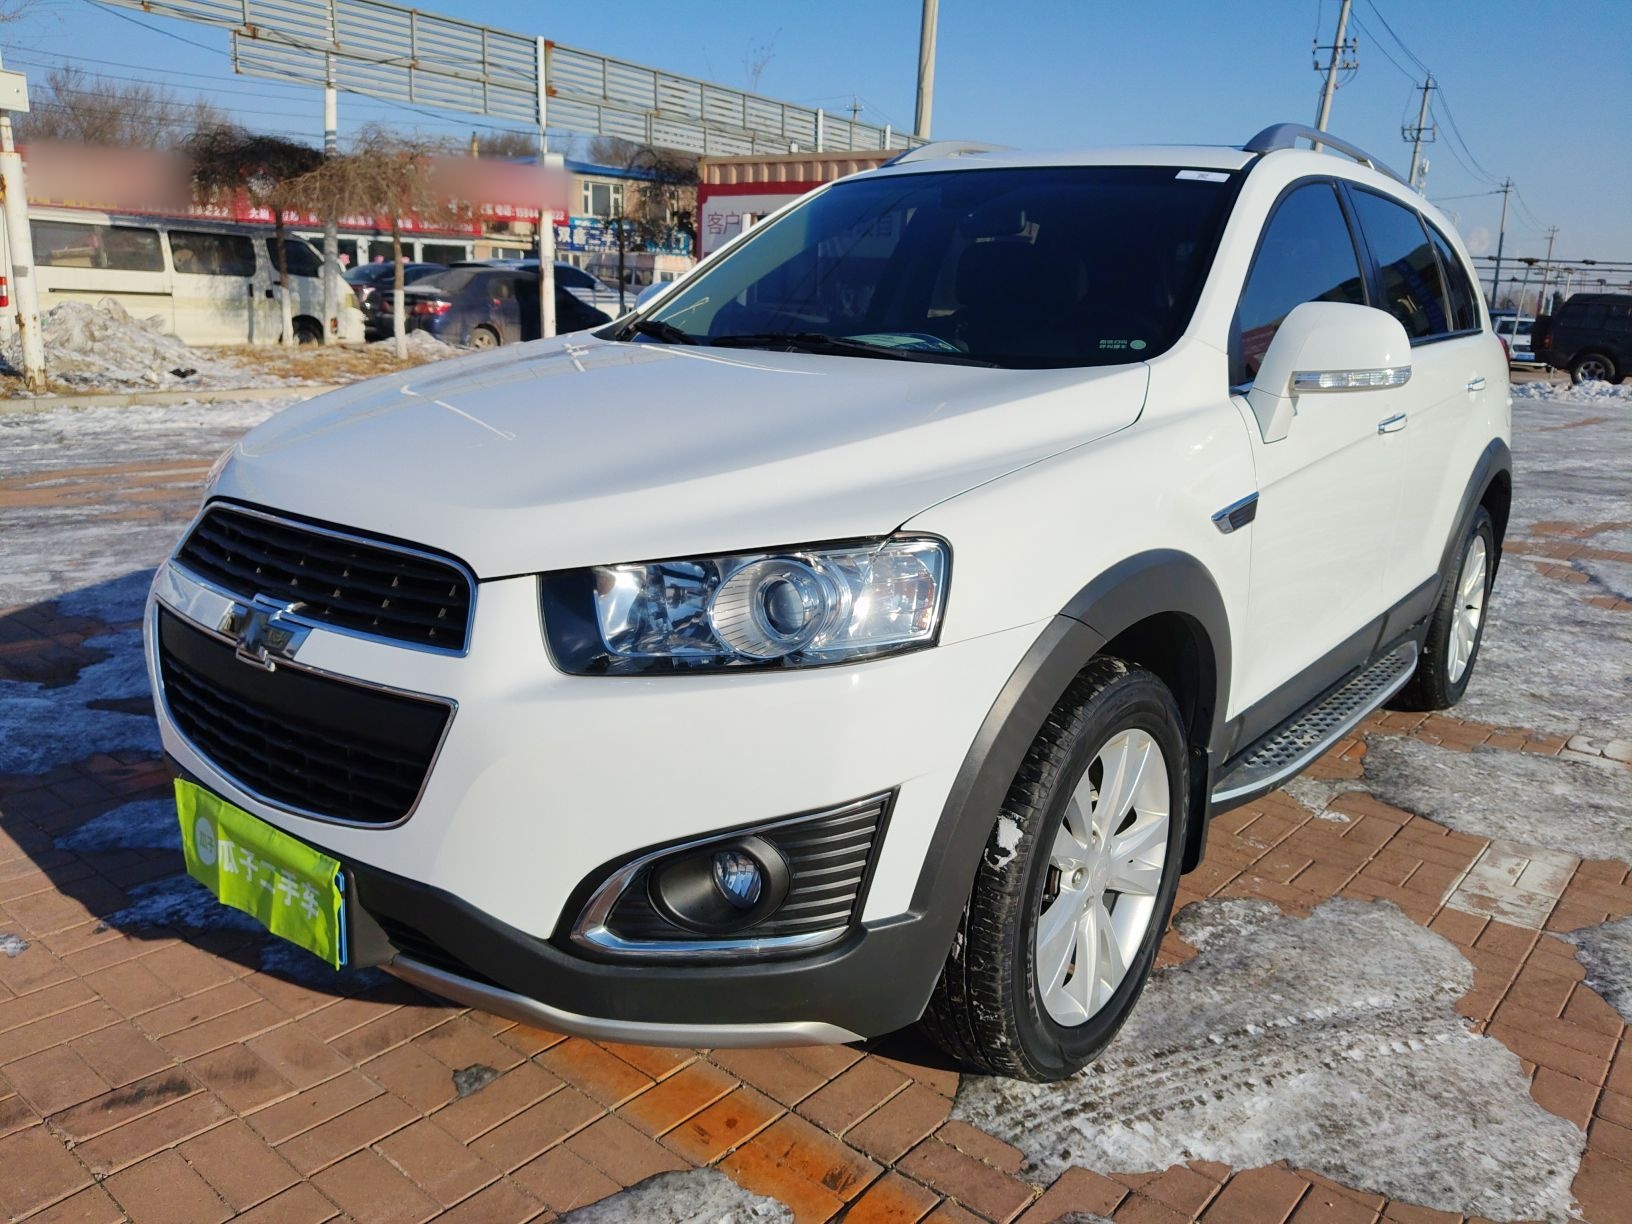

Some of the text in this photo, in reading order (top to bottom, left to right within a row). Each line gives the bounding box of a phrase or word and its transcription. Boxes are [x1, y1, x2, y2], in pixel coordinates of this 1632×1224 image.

[707, 211, 769, 235] 客户
[218, 839, 321, 919] 瓜子二手车
